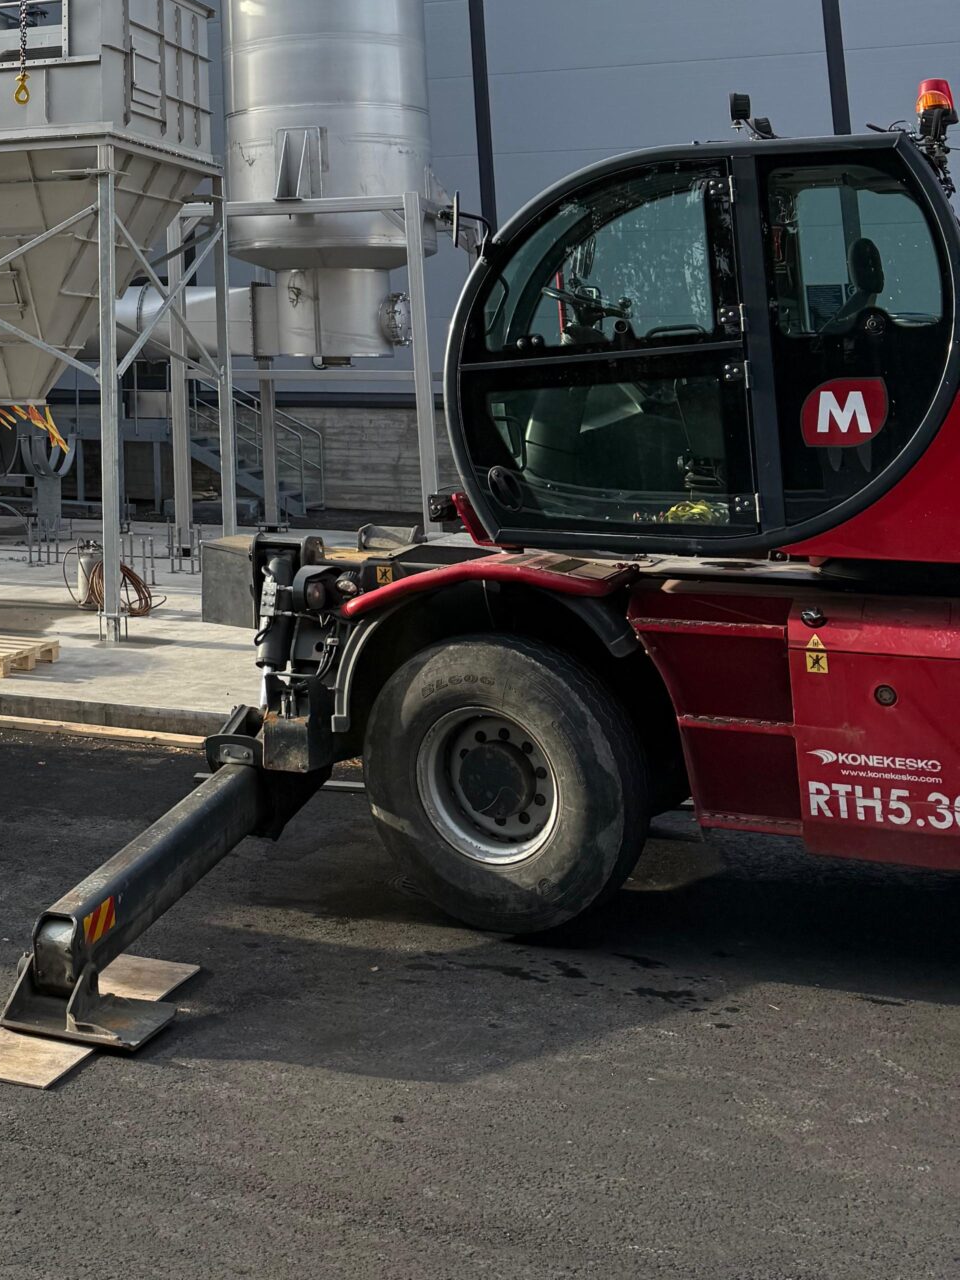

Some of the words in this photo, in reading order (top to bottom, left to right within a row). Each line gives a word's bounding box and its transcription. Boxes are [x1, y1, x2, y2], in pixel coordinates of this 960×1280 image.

[816, 390, 872, 433] M
[837, 752, 942, 773] KONEKESKO
[840, 768, 943, 784] www.konekesko.com
[807, 780, 960, 830] RTH5.3
